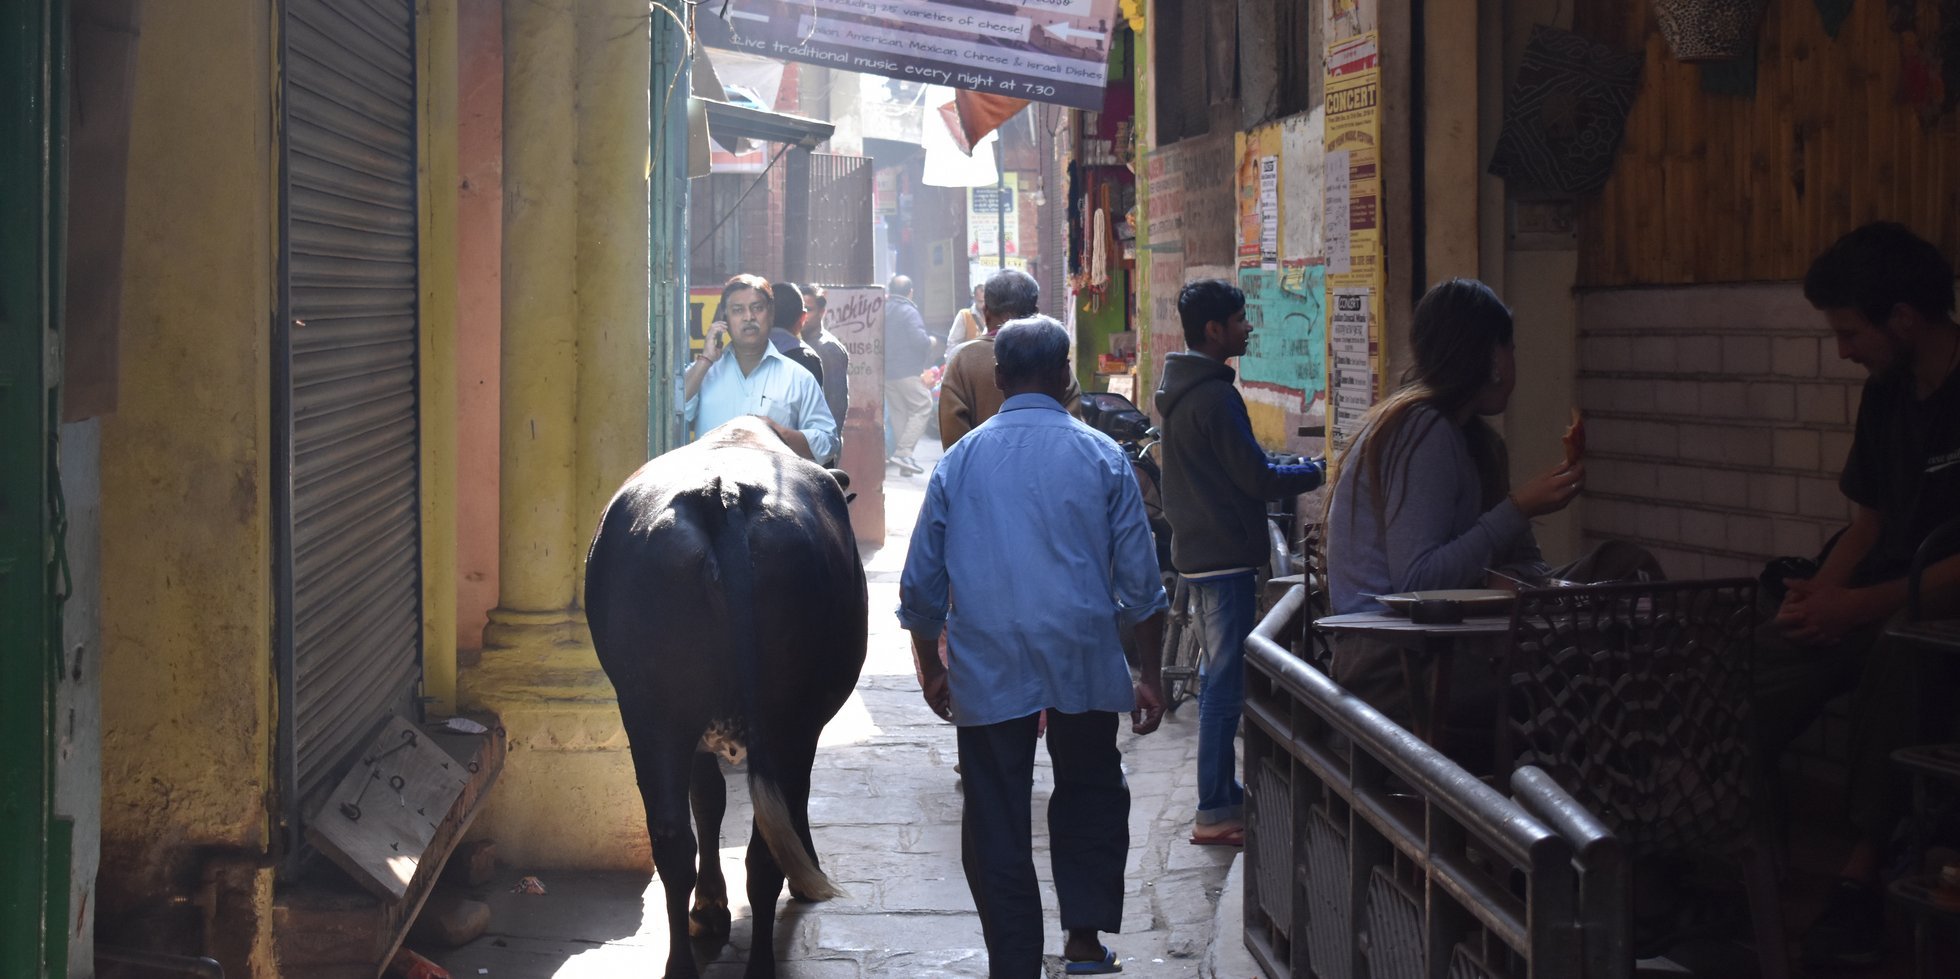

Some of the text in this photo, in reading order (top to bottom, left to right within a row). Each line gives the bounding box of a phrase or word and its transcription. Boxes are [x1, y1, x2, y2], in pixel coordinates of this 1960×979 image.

[903, 8, 954, 23] varieties
[958, 14, 974, 26] of
[978, 20, 1024, 36] cheese!
[732, 36, 1055, 97] Live traditional music every night at 7.30
[964, 50, 1009, 65] Chinese
[1013, 56, 1022, 67] &
[1027, 61, 1062, 74] Israeli
[1065, 66, 1102, 80] Dishes
[1326, 84, 1376, 115] CONCERT
